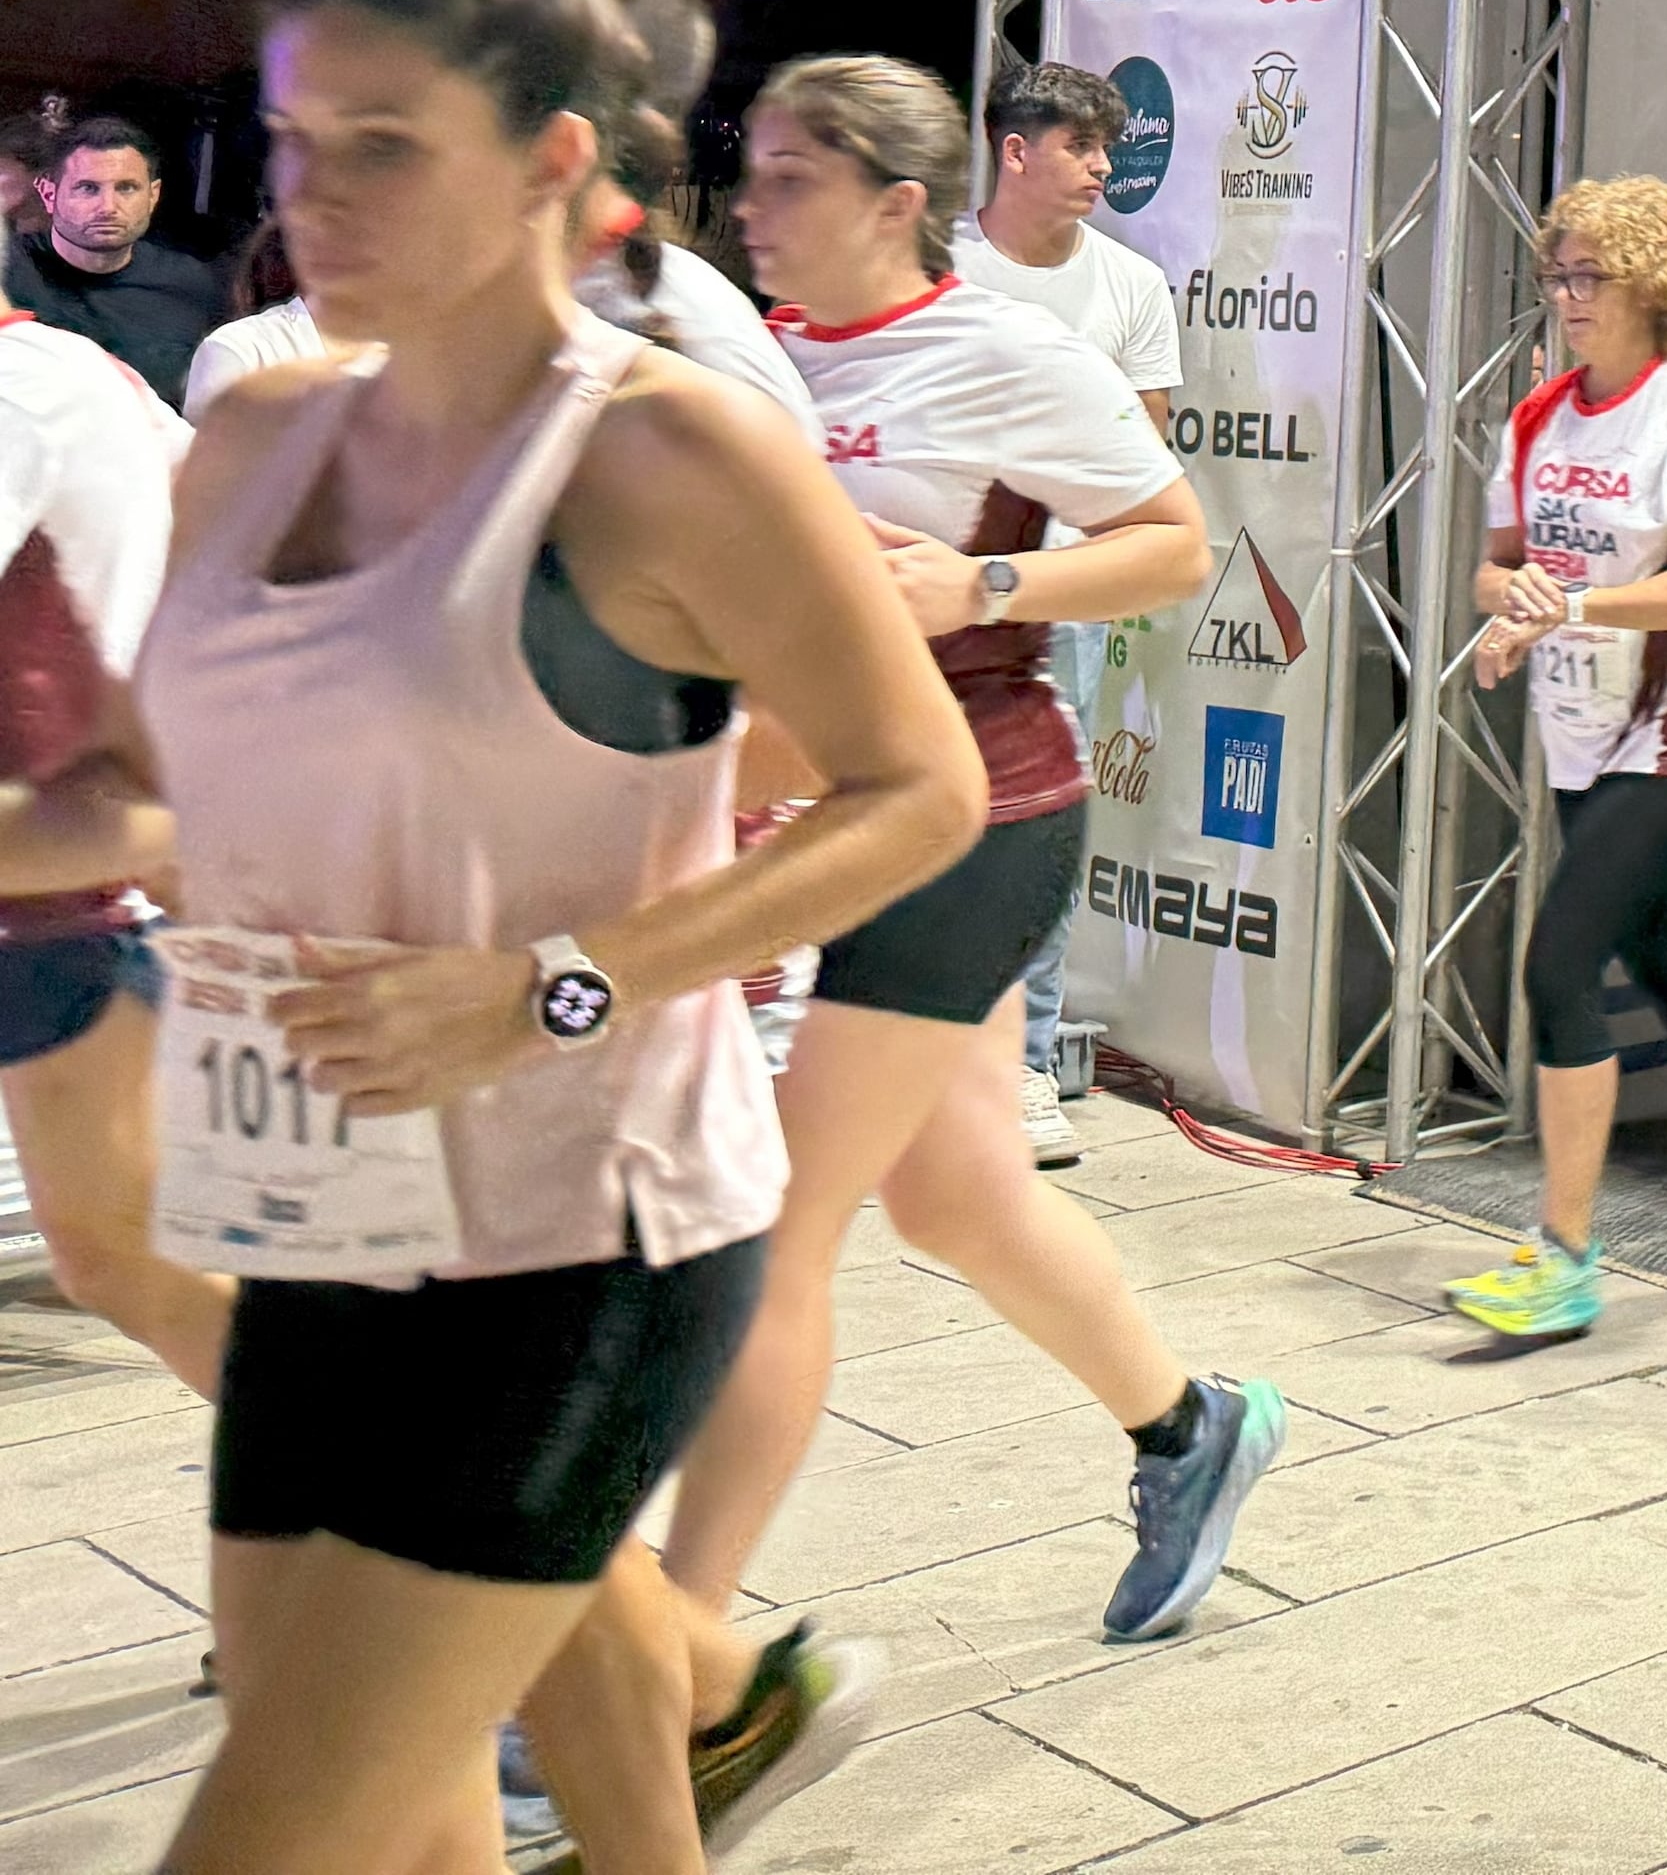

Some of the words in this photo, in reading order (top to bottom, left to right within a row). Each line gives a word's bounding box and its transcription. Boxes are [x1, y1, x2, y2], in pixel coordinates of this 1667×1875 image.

[1256, 169, 1313, 199] TRAINING
[1186, 269, 1318, 333] florida
[1213, 410, 1309, 463] BELL
[1533, 462, 1632, 502] CURSA
[1210, 618, 1275, 664] 7KL
[1221, 755, 1267, 815] PADI
